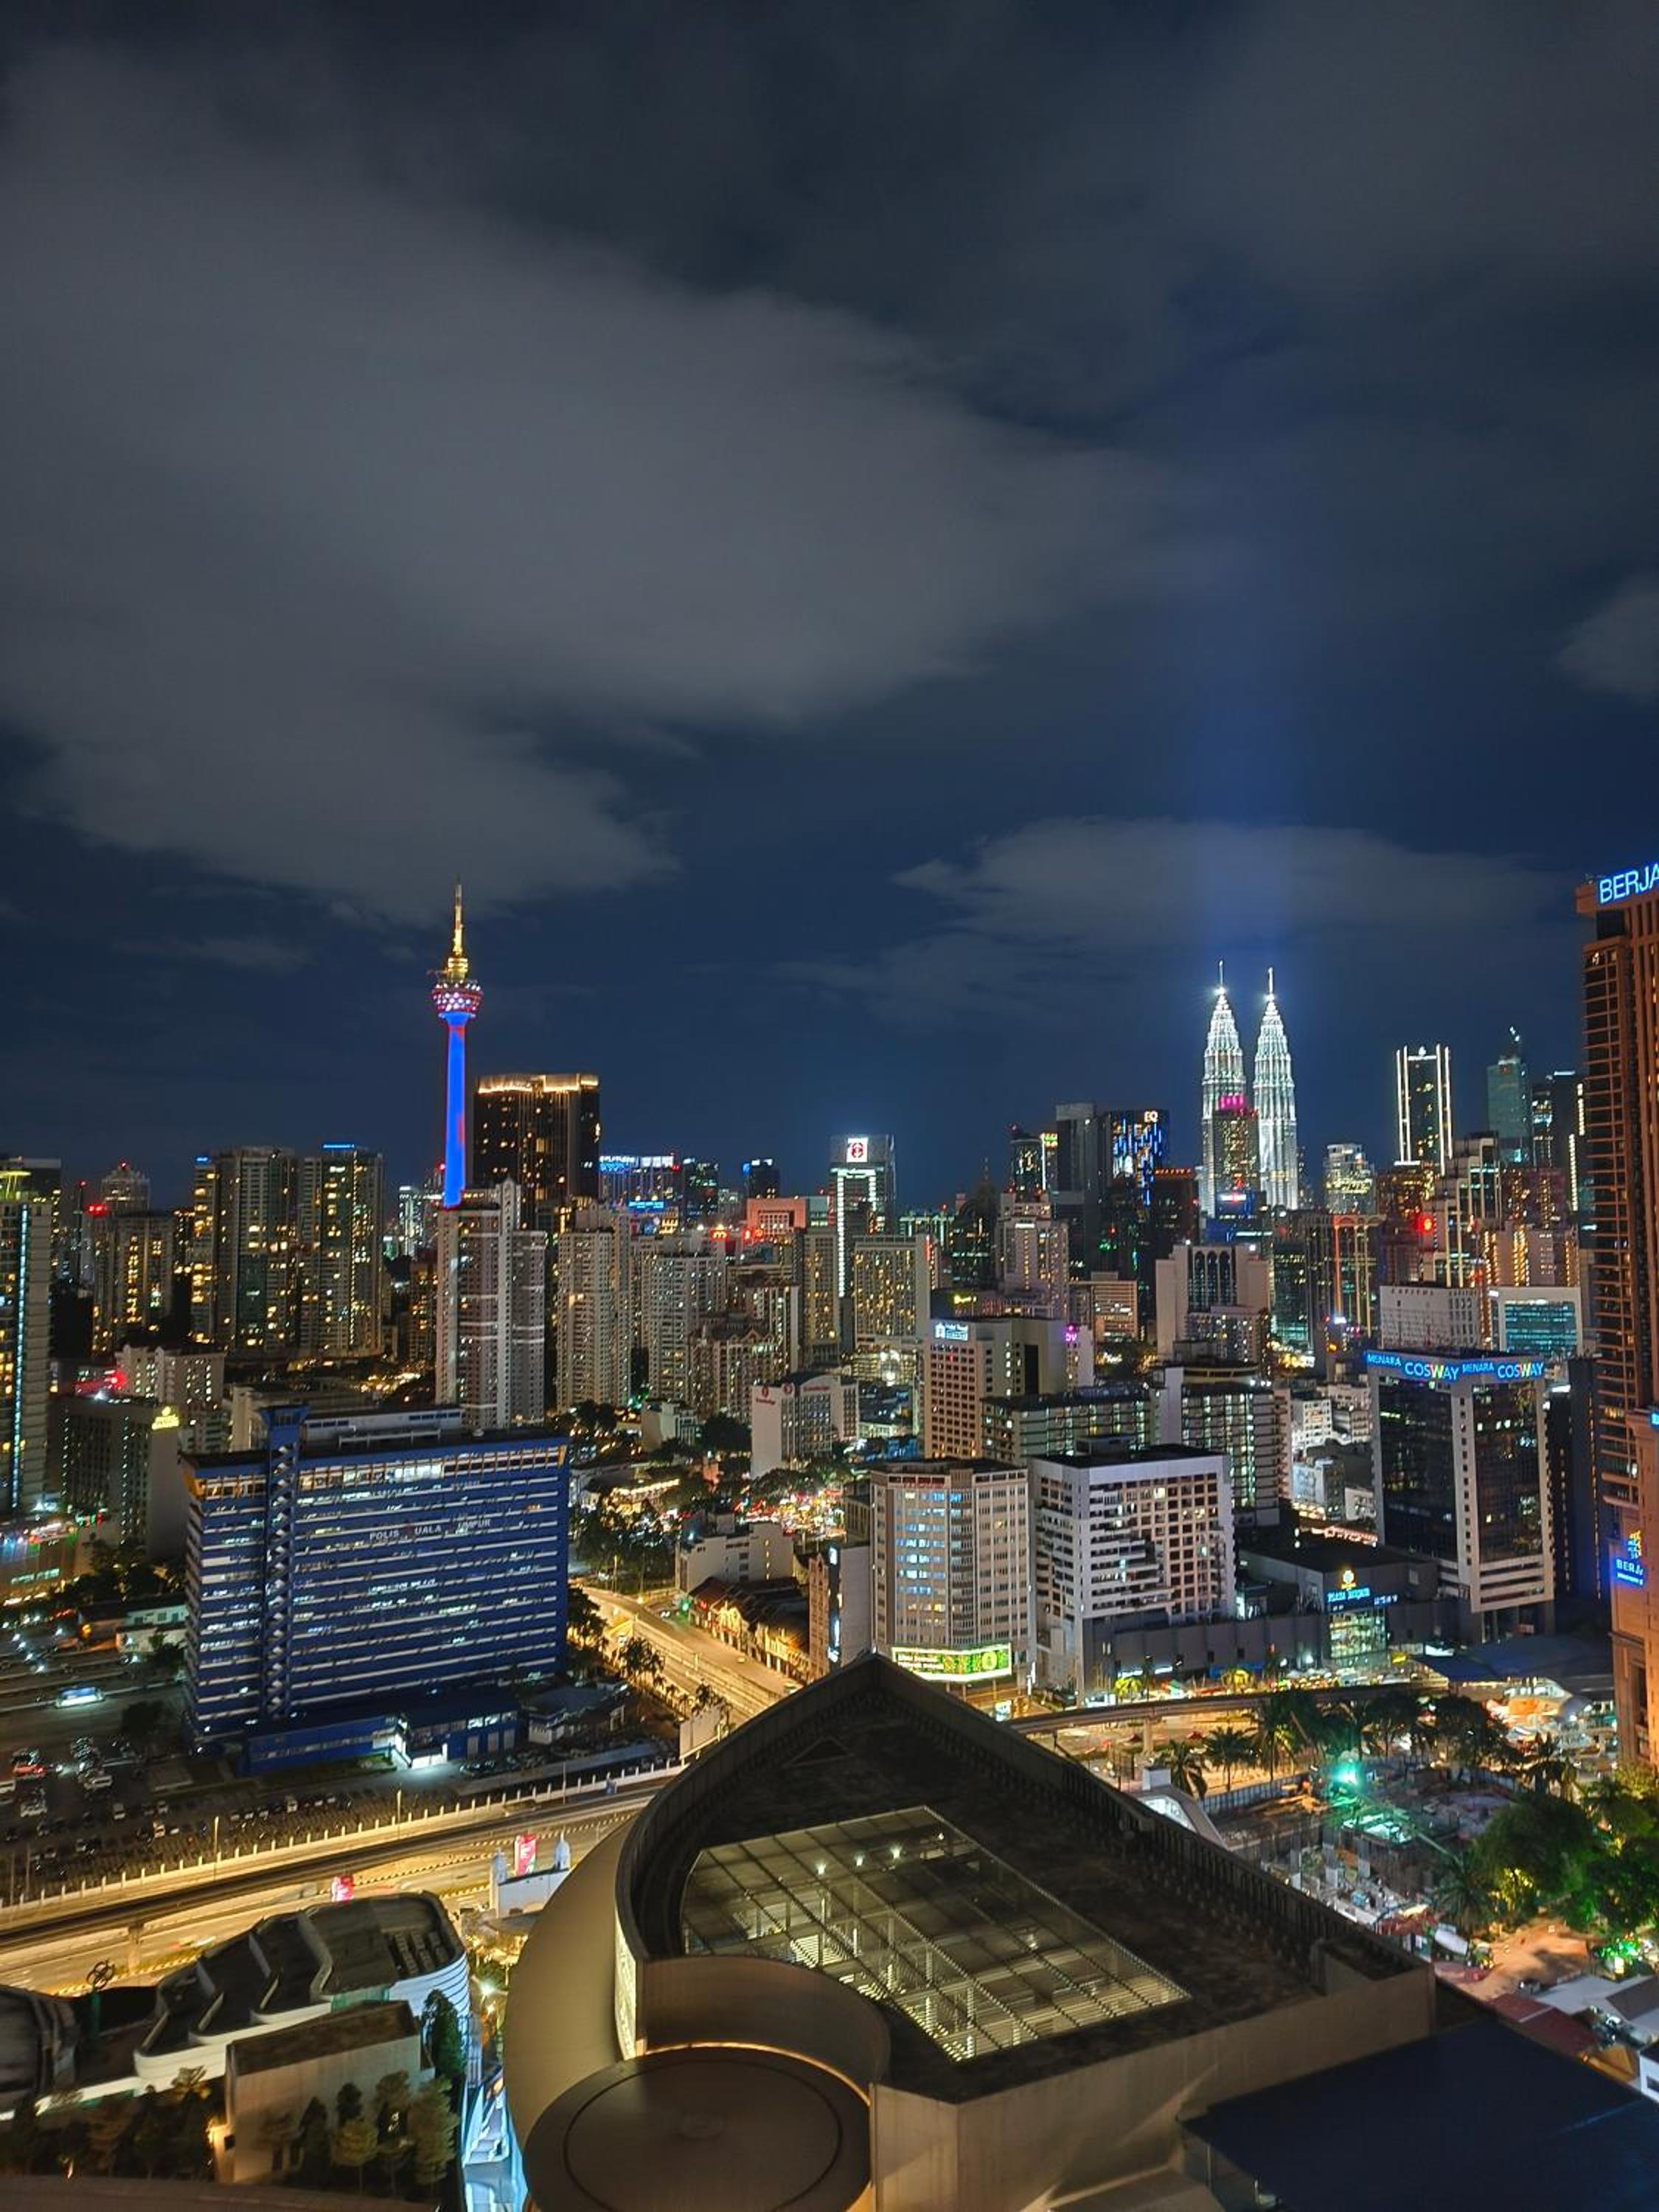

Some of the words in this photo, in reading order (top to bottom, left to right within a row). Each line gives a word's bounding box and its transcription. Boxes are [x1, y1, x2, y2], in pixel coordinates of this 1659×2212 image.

[1599, 863, 1659, 904] BERJA
[1144, 1110, 1158, 1123] EQ
[1404, 1362, 1460, 1381] COSWAY
[1498, 1362, 1545, 1378] COSWAY
[369, 1530, 400, 1540] POLIS
